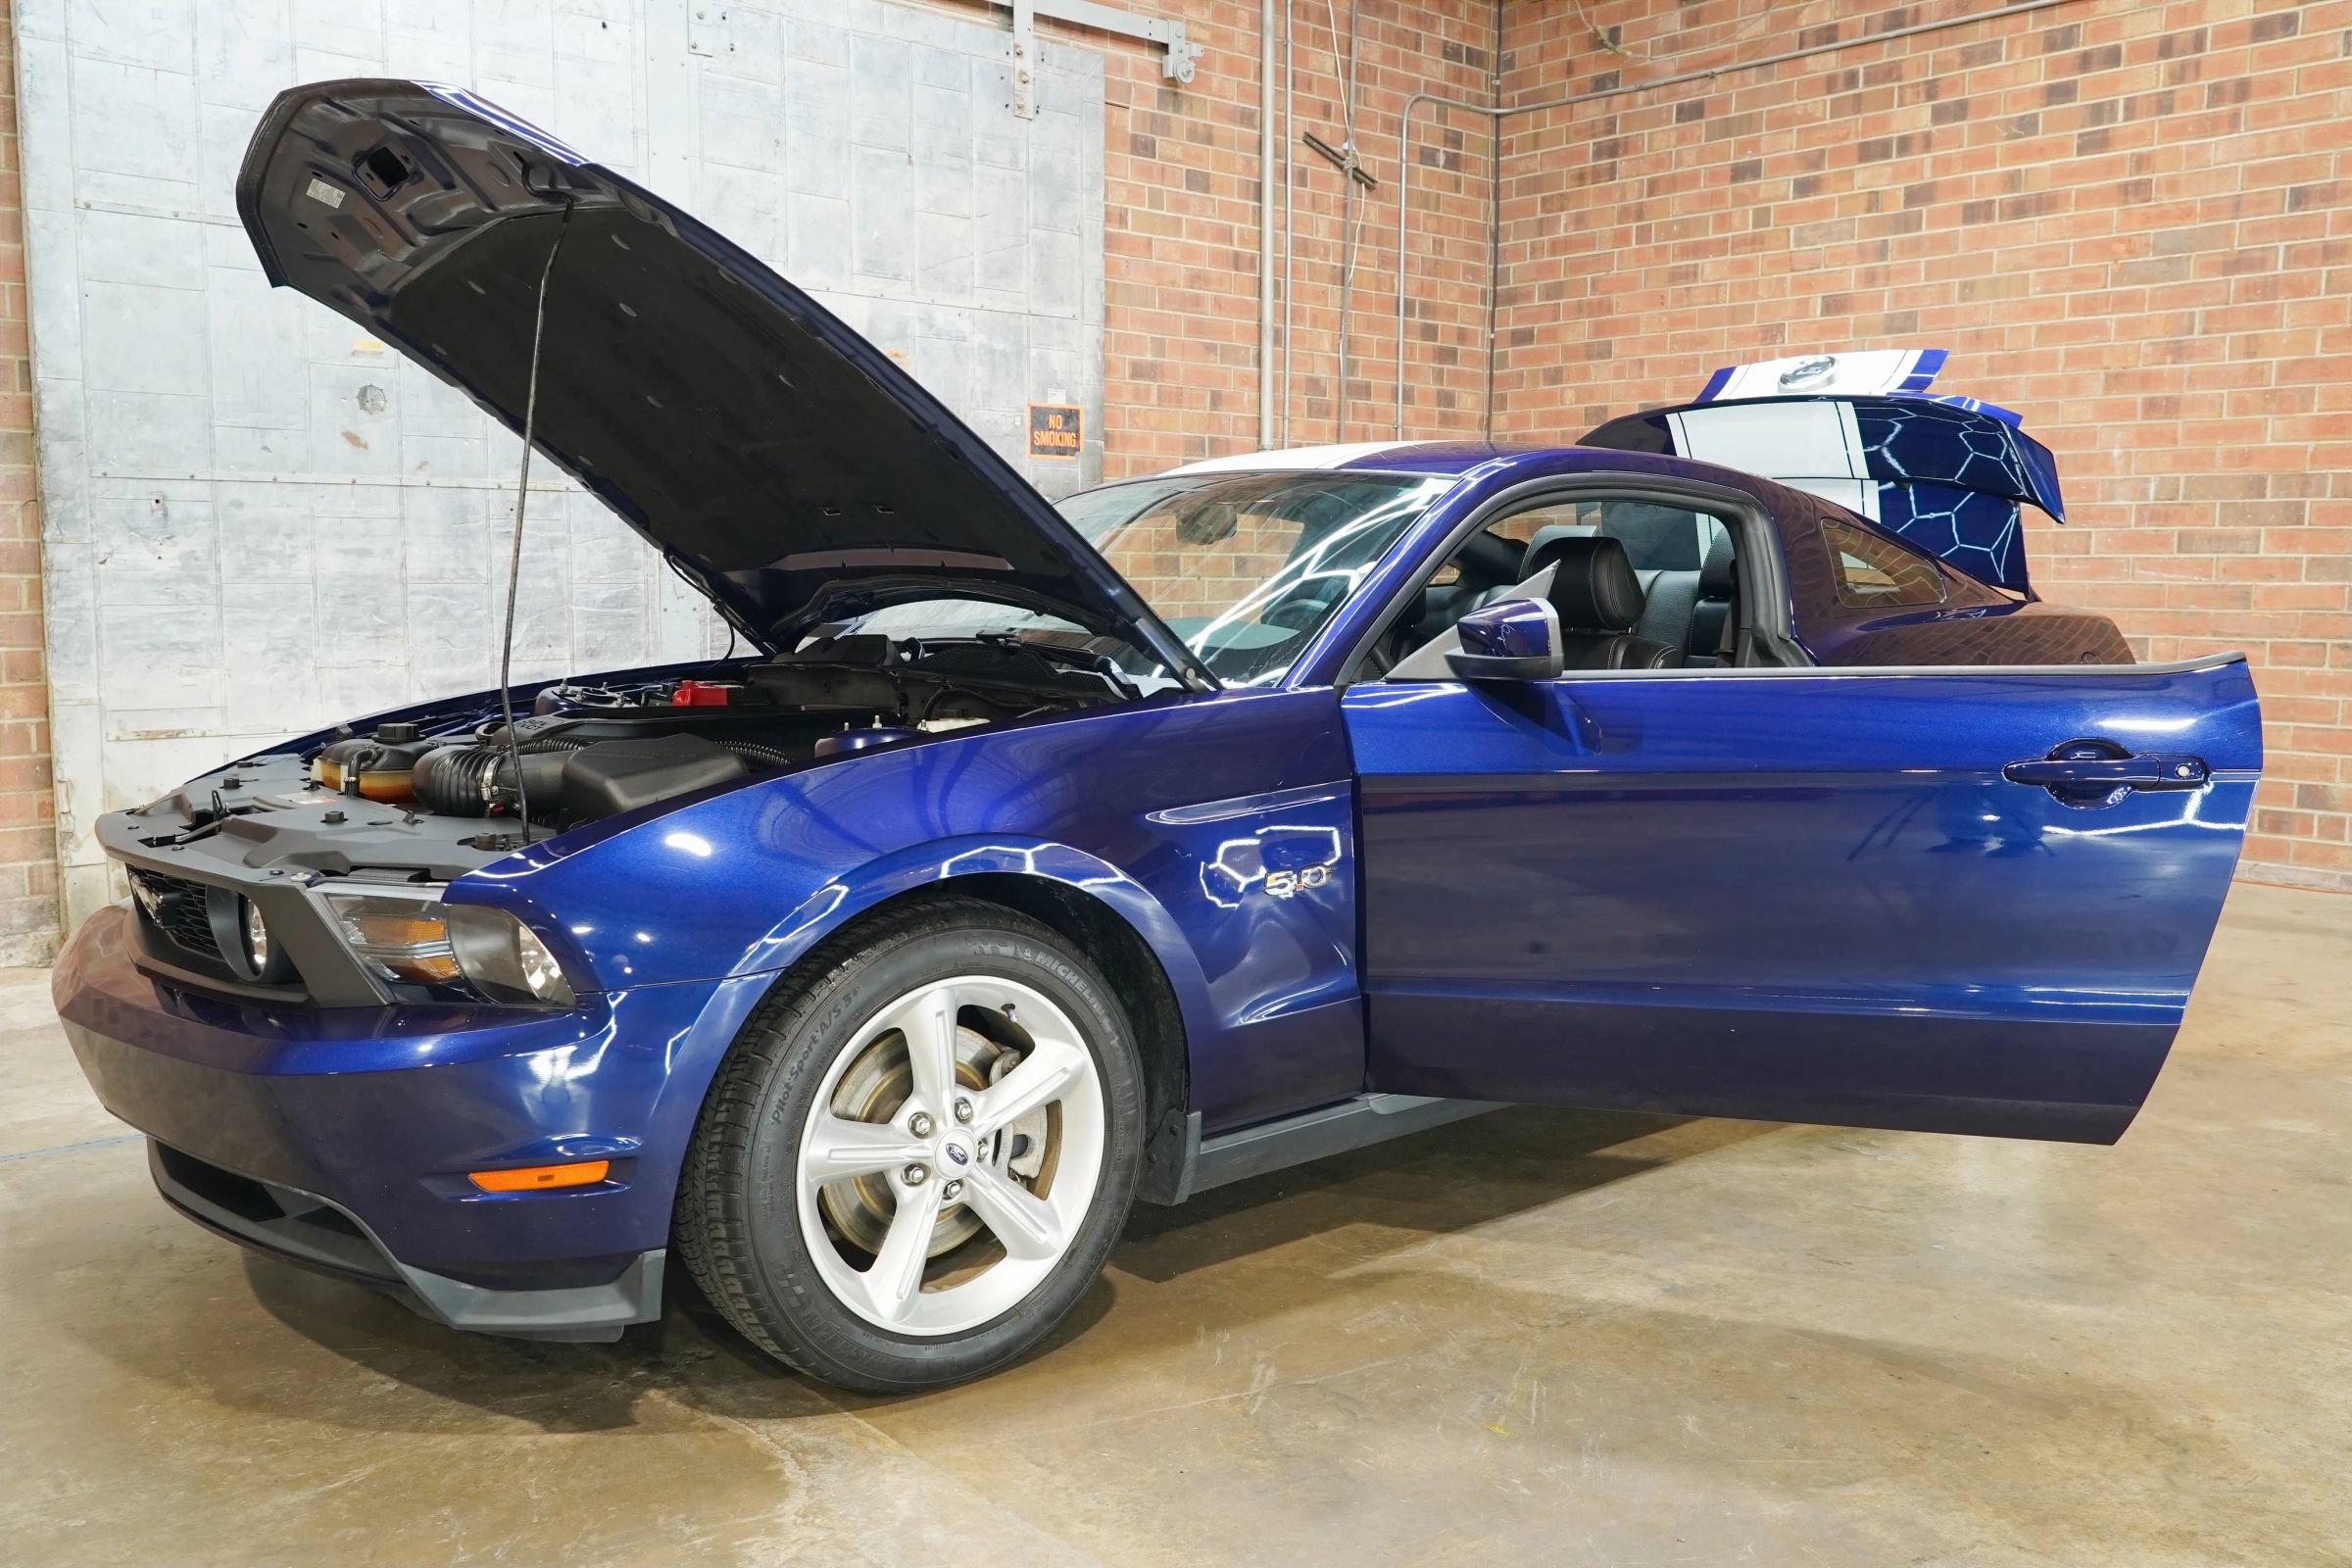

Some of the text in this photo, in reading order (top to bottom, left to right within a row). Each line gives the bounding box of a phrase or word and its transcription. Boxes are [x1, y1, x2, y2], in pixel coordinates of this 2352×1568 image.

[1034, 431, 1076, 447] SMOKING
[1049, 415, 1062, 429] NO
[1262, 863, 1331, 897] 5.0
[1035, 951, 1105, 1018] MICHELIN
[771, 1081, 794, 1125] Pilot
[790, 1034, 819, 1081] Sport
